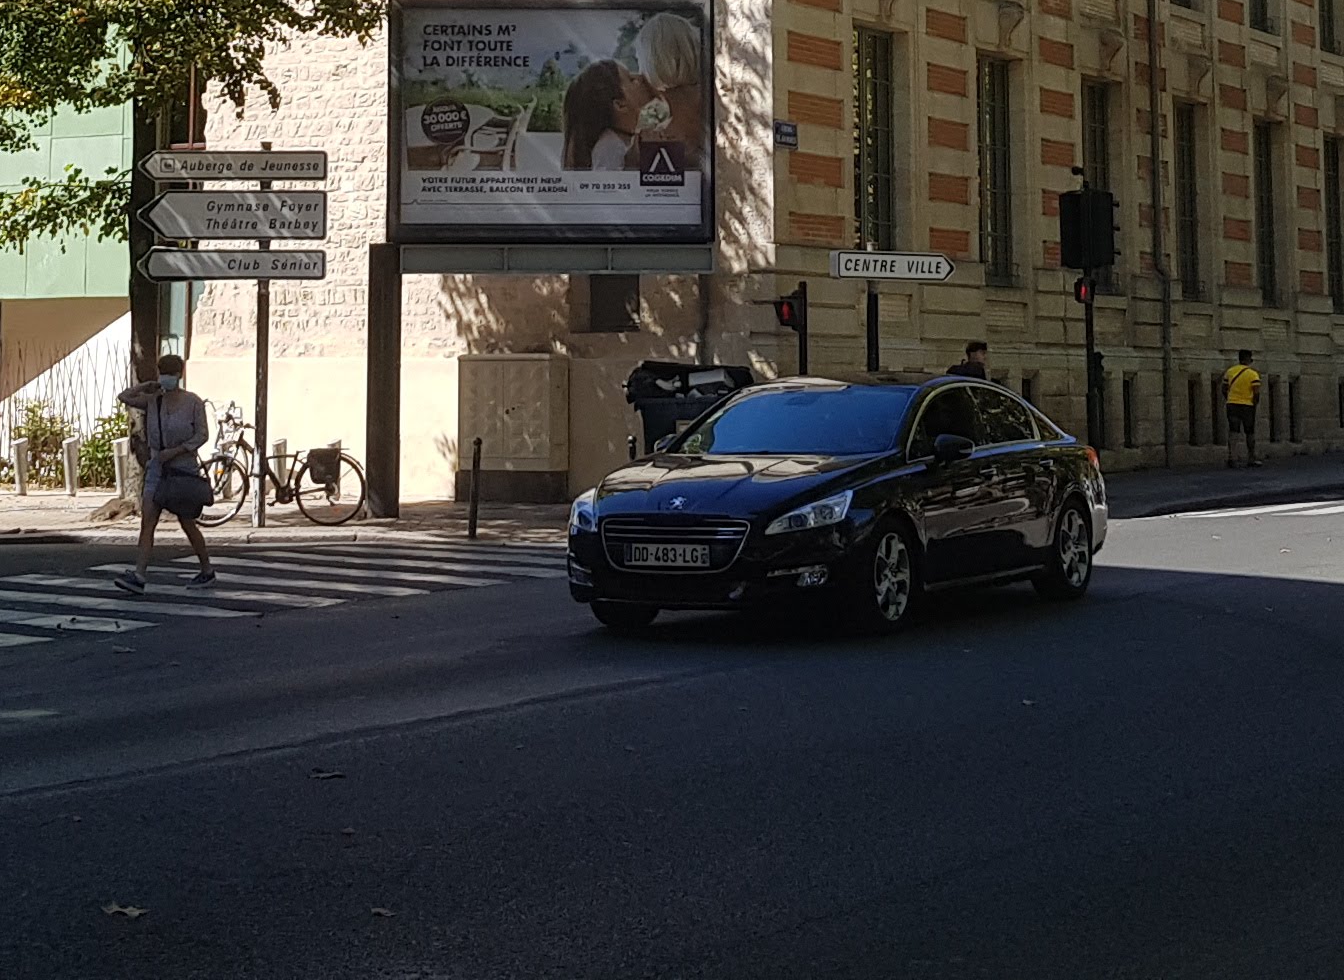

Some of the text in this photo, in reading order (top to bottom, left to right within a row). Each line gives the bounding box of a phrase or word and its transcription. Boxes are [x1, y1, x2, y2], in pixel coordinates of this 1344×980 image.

[423, 24, 492, 36] CERTAINS
[423, 40, 513, 52] FONT TOUTE
[423, 53, 530, 67] LA DIFFÉRENCE
[180, 160, 319, 173] Auberge de Jeunesse
[445, 186, 486, 194] TERRASSE,
[206, 200, 319, 214] Gymnase Foyer
[206, 218, 318, 232] Théâtre Barbey
[227, 258, 318, 270] Club Sénior
[844, 258, 943, 274] CENTRE VILLE
[634, 546, 699, 564] DD-483-LG
